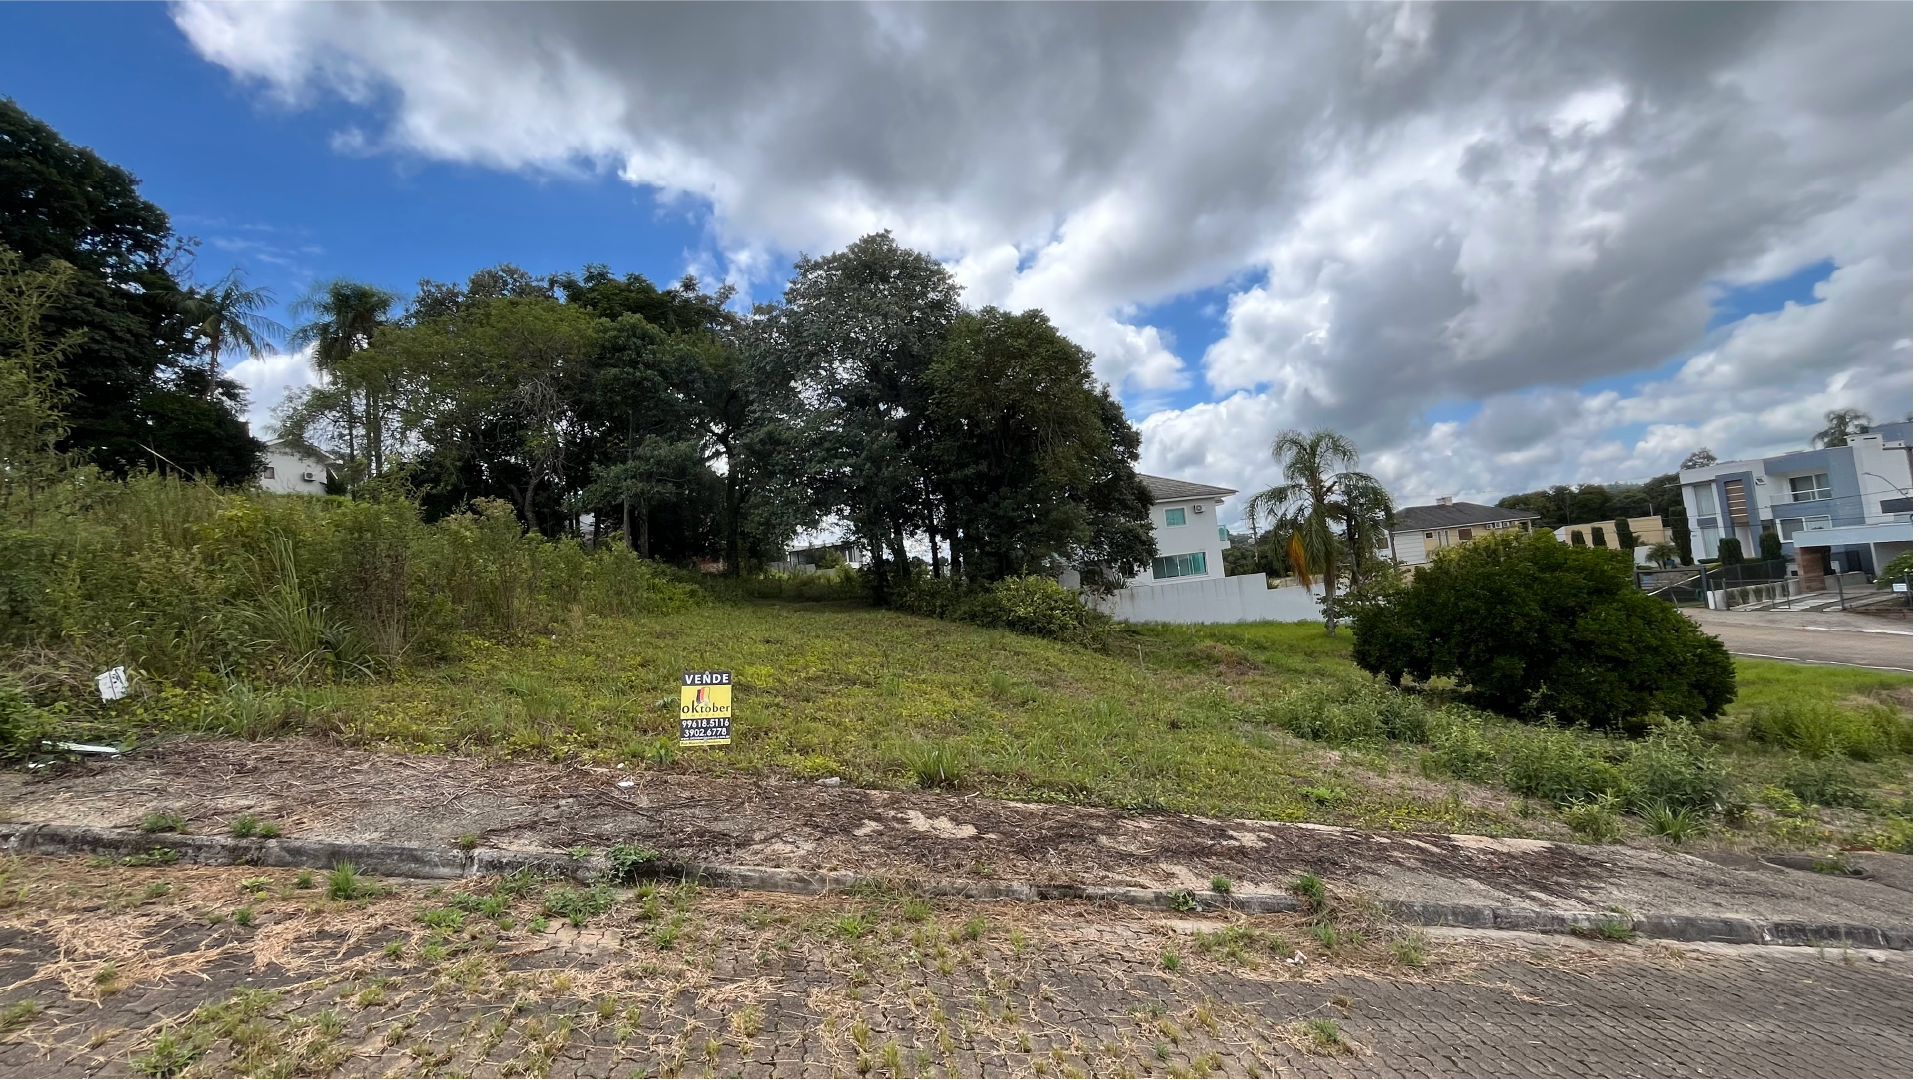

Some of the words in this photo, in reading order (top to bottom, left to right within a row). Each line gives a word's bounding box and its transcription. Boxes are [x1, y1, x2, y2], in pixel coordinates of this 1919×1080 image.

[685, 674, 729, 684] VENDE
[682, 718, 730, 728] 99618.5116
[684, 728, 727, 737] 3902.6778
